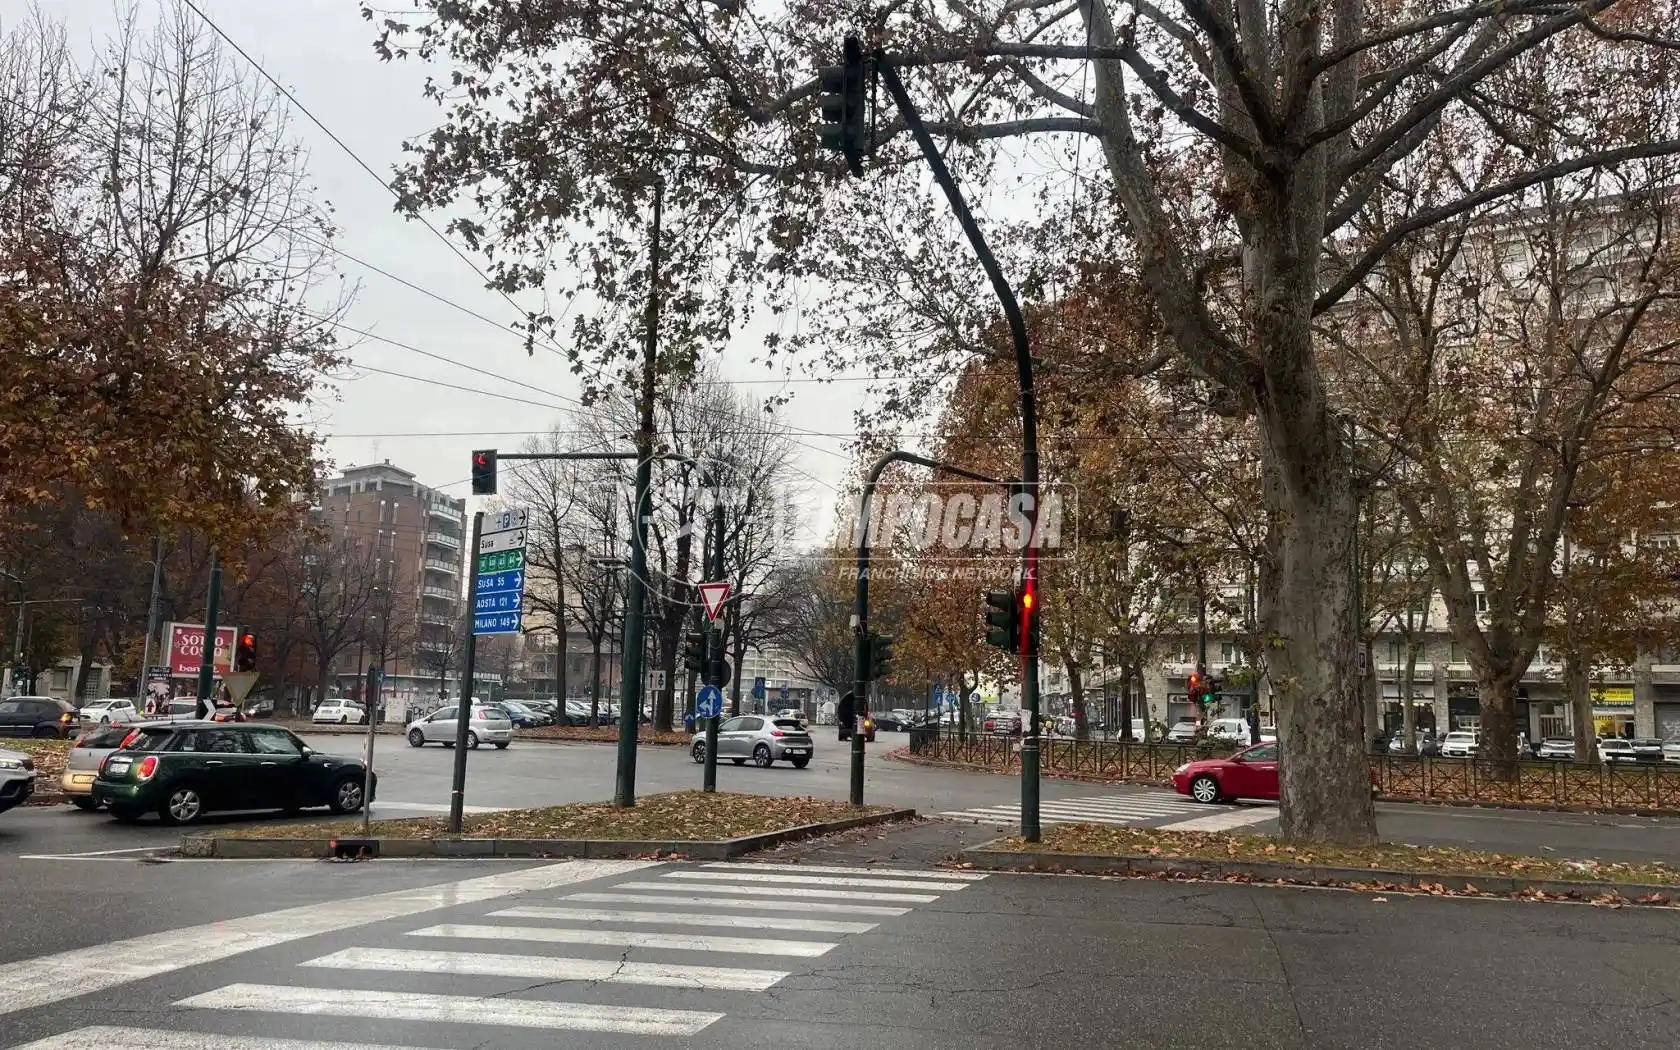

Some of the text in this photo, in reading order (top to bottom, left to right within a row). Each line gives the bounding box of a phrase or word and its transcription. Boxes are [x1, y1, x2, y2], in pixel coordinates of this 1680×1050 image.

[478, 577, 505, 589] SUSA 55
[476, 597, 508, 608] AOSTA 121
[475, 618, 497, 628] MILANO
[181, 634, 224, 646] SOTO
